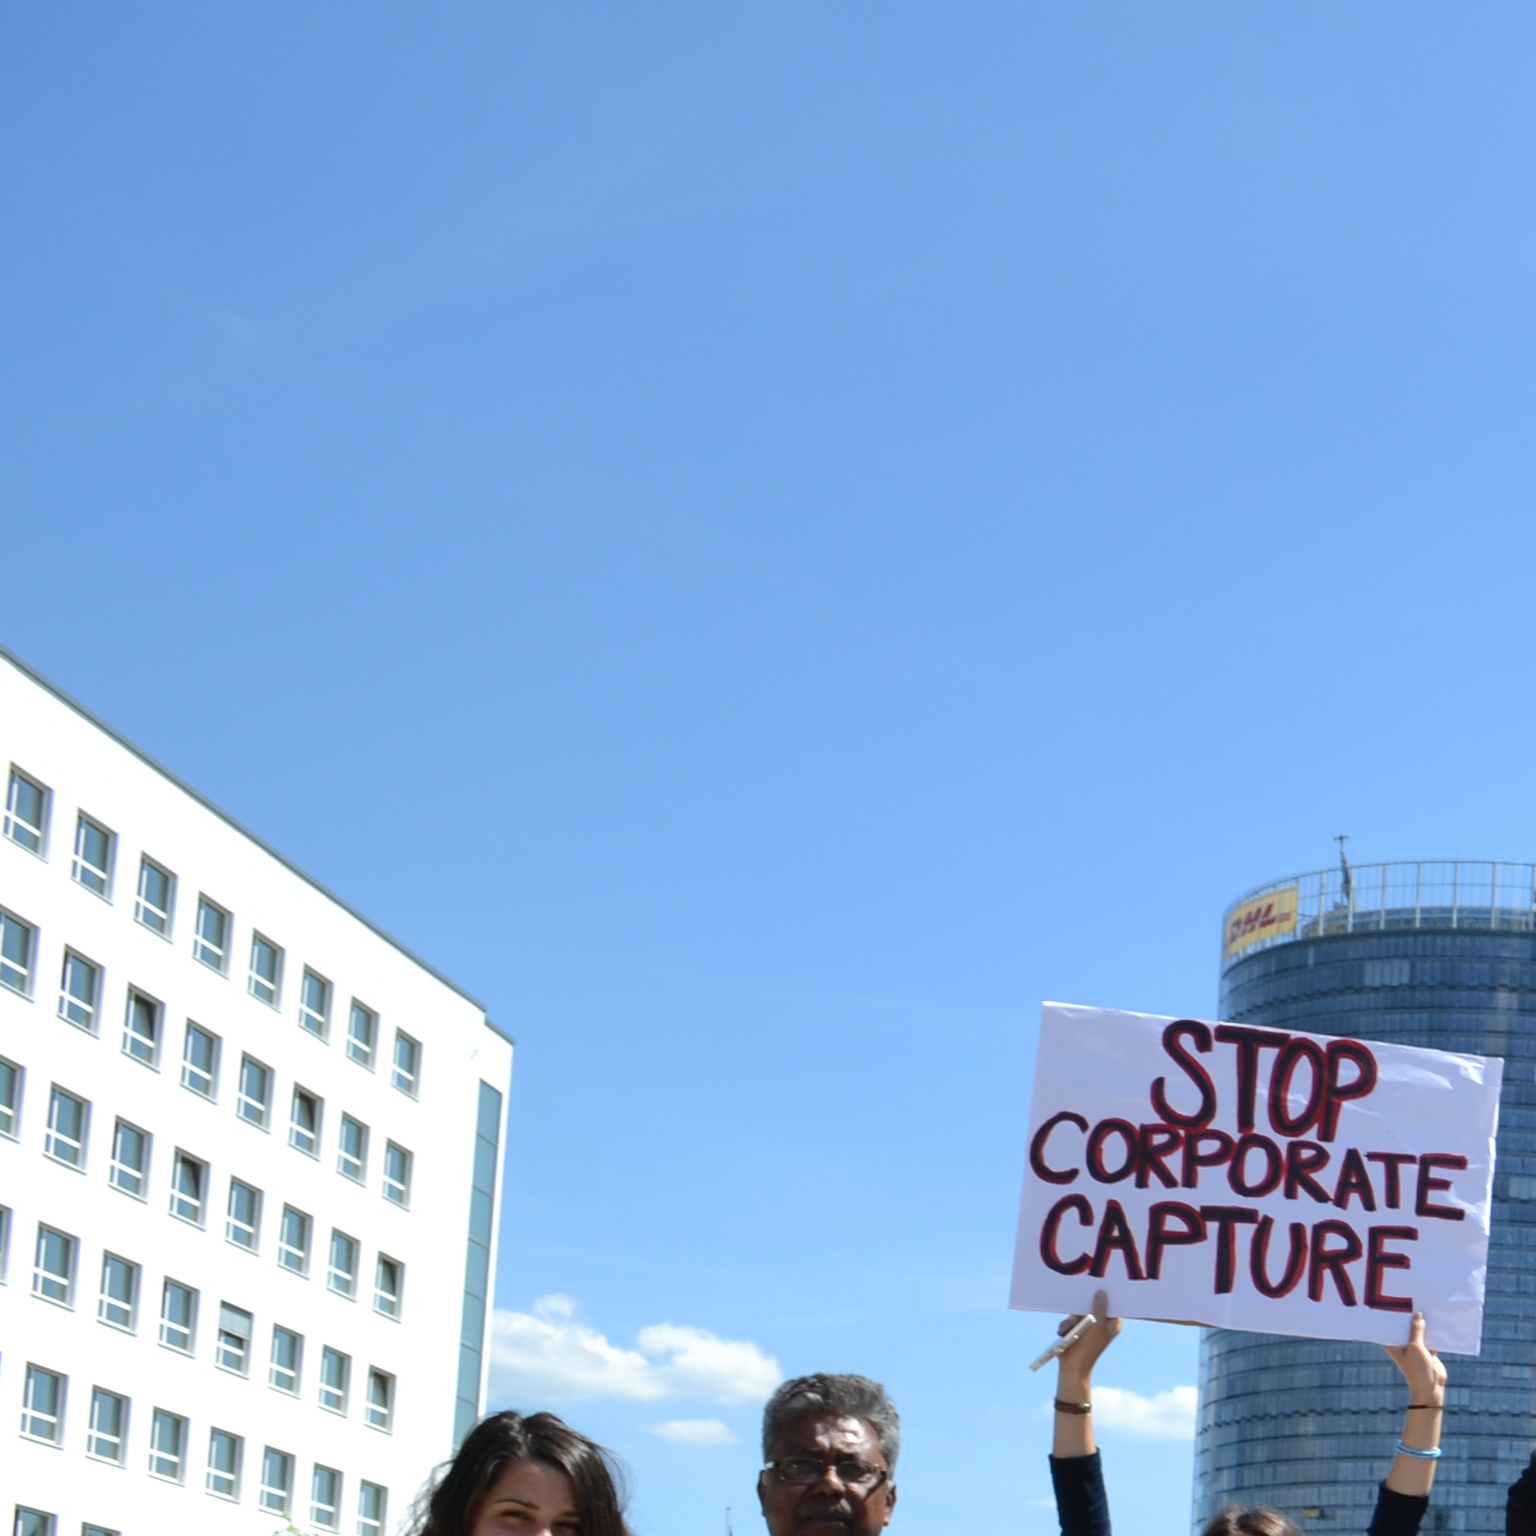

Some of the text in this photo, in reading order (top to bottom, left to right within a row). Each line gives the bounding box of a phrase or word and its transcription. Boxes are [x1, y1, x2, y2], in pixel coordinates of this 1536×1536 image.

[1150, 1019, 1378, 1142] STOP
[1029, 1111, 1468, 1221] CORPORATE
[1040, 1194, 1419, 1312] CAPTURE
